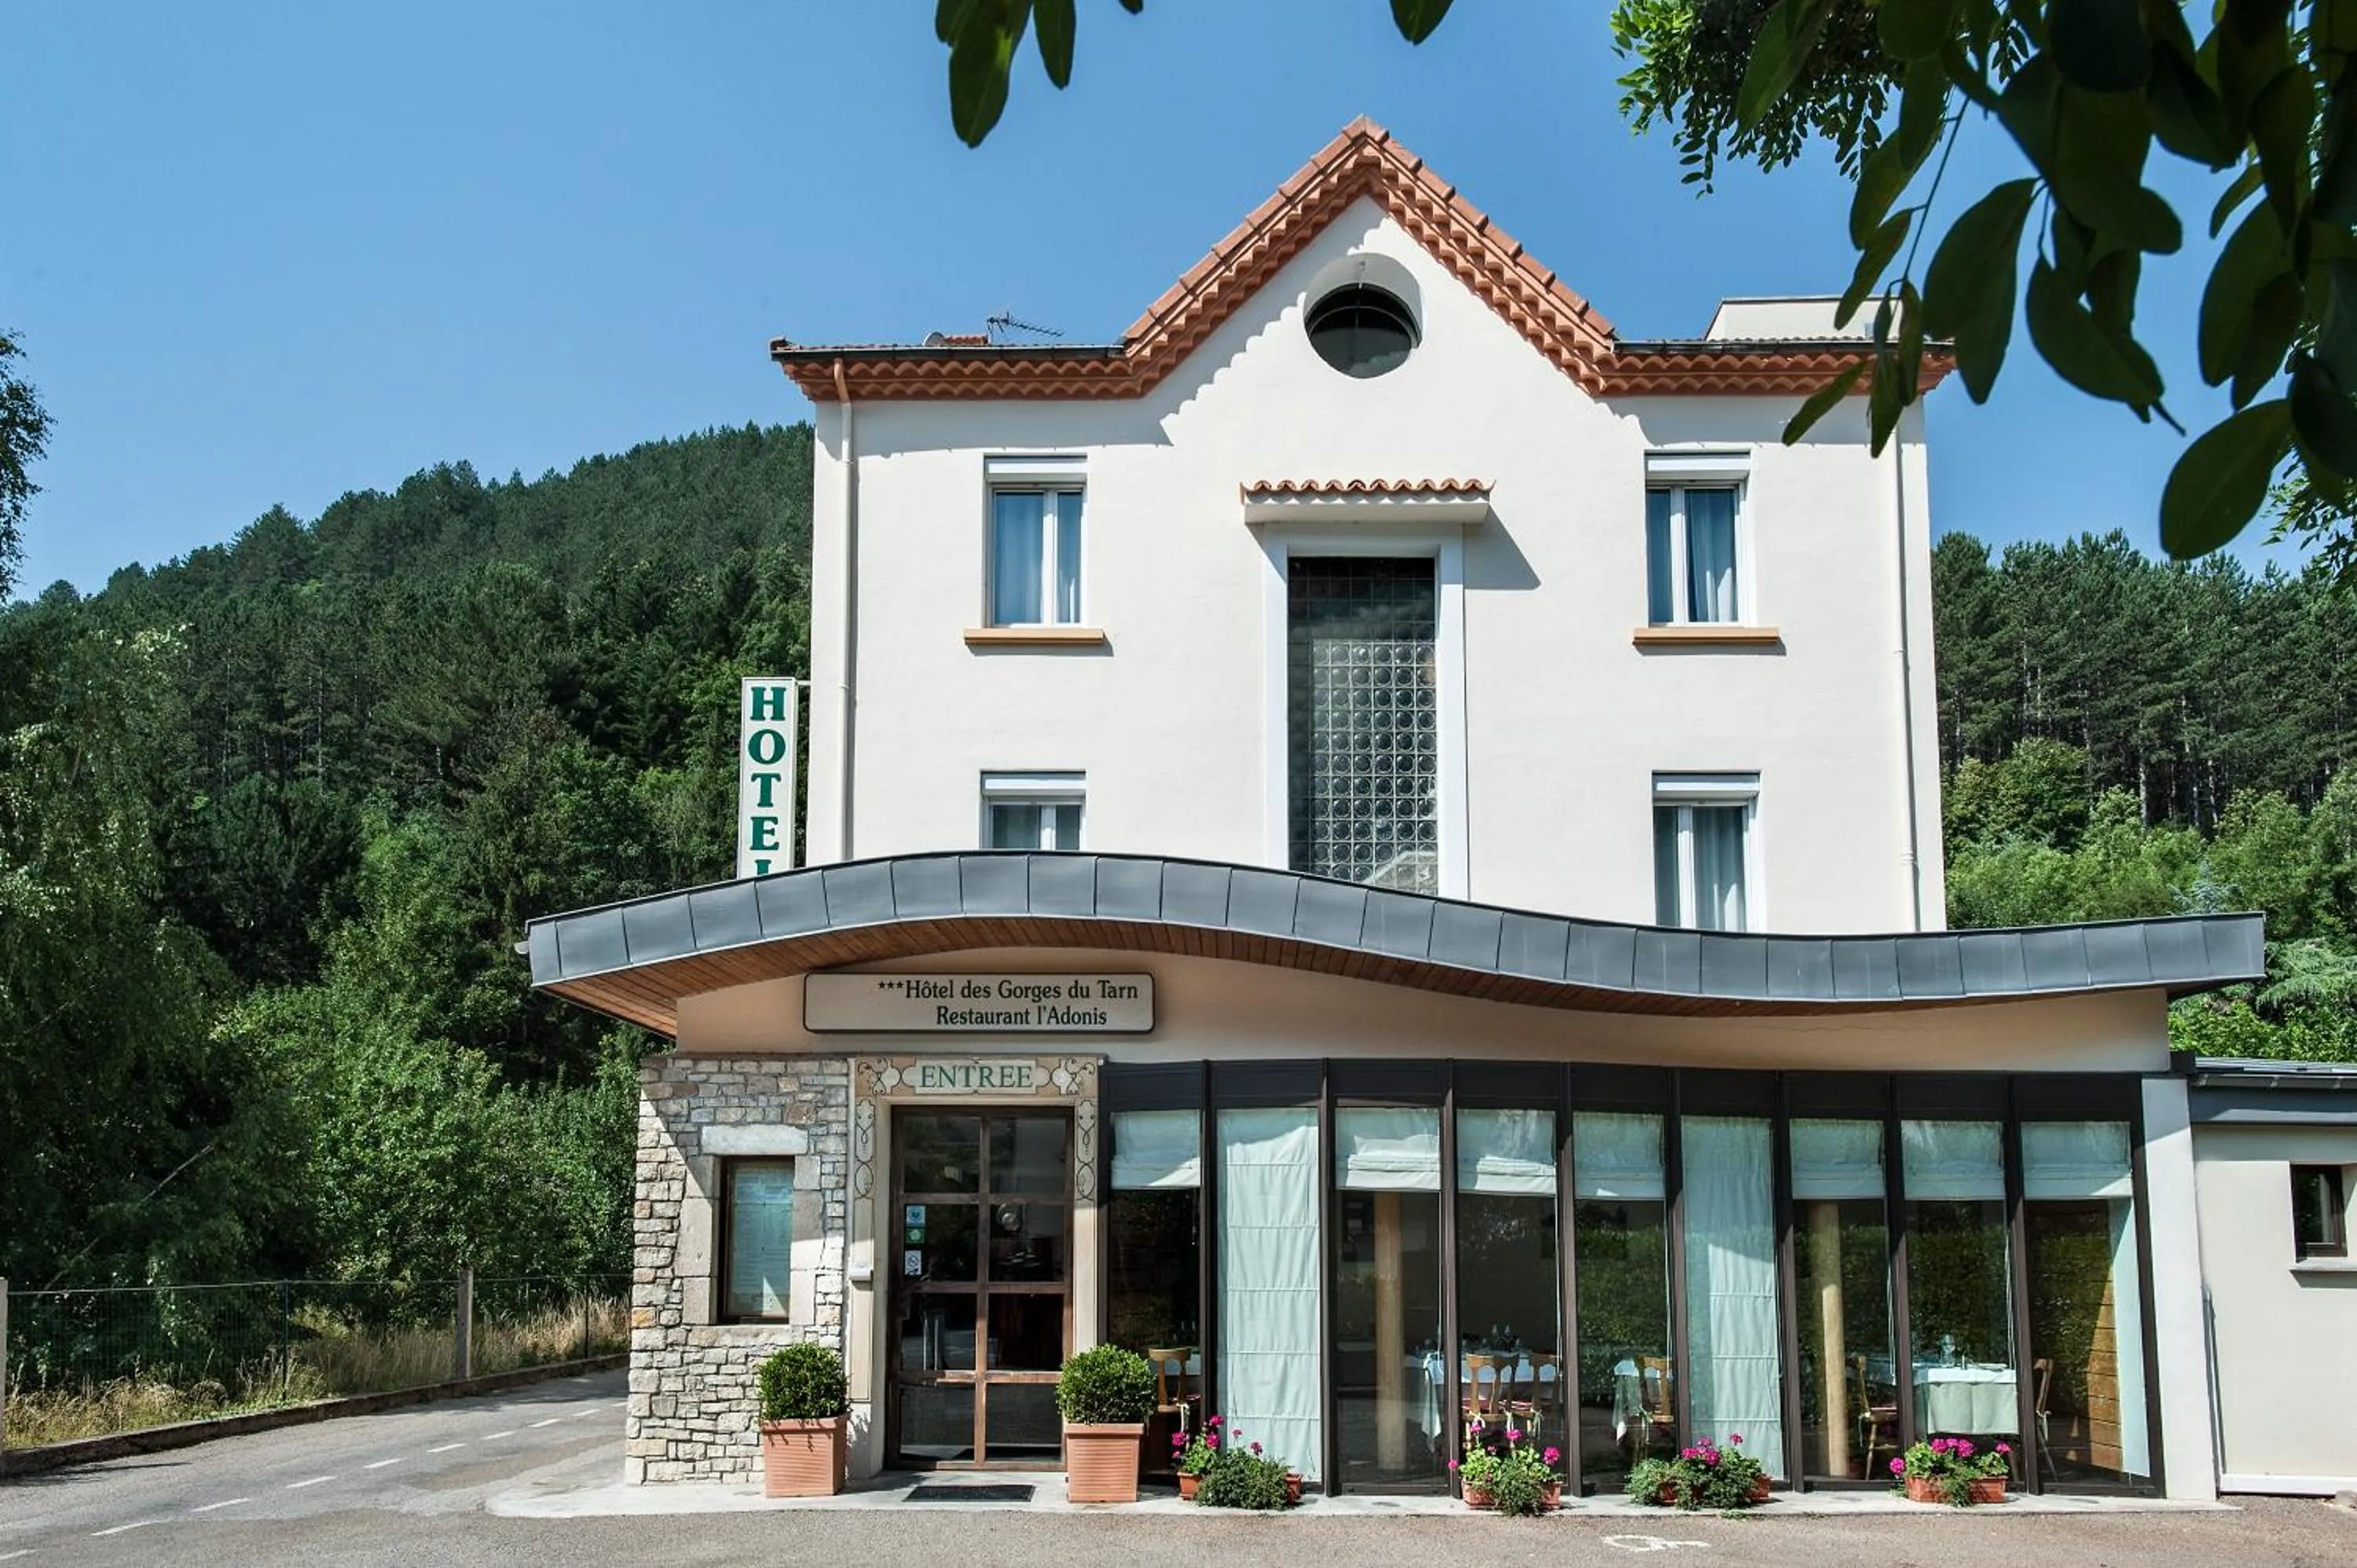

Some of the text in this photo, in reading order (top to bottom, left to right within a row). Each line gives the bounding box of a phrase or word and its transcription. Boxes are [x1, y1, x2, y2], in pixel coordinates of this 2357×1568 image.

[904, 978, 1138, 1002] Hôtel des Gorges du Tarn
[936, 1006, 1107, 1025] Restaurant l'Adonis
[920, 1065, 1033, 1089] ENTREE
